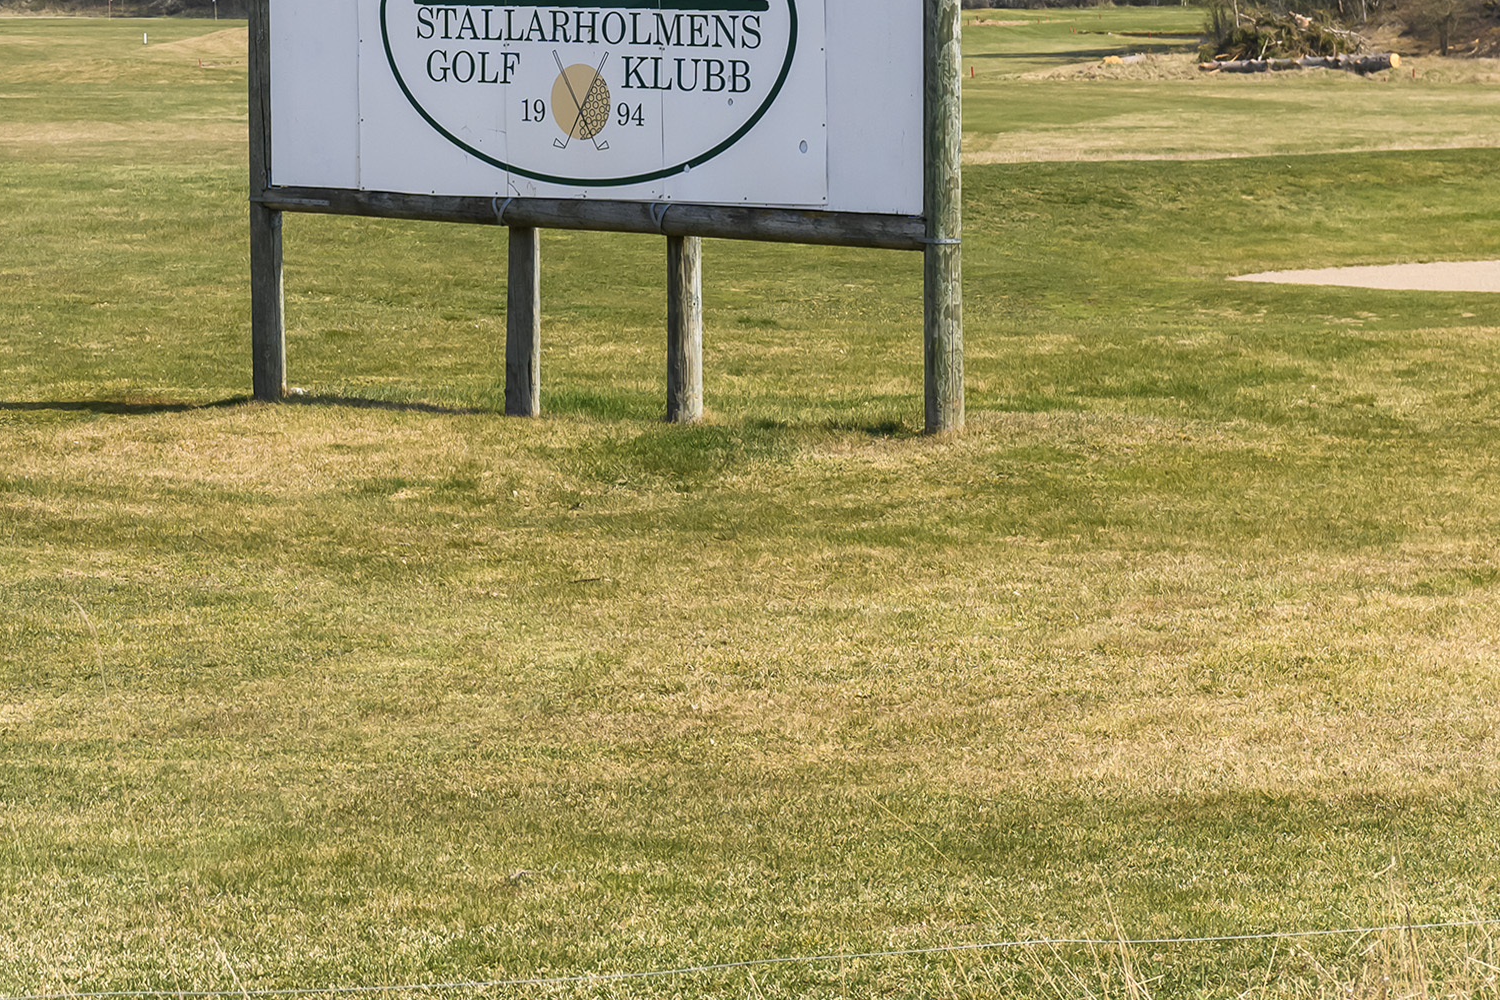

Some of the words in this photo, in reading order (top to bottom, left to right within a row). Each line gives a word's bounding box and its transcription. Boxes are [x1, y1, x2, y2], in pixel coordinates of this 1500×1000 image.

[416, 6, 763, 50] STALLARHOLMENS
[425, 49, 521, 85] GOLF
[620, 55, 752, 94] KLUBB
[520, 97, 546, 123] 19
[616, 102, 646, 128] 94
